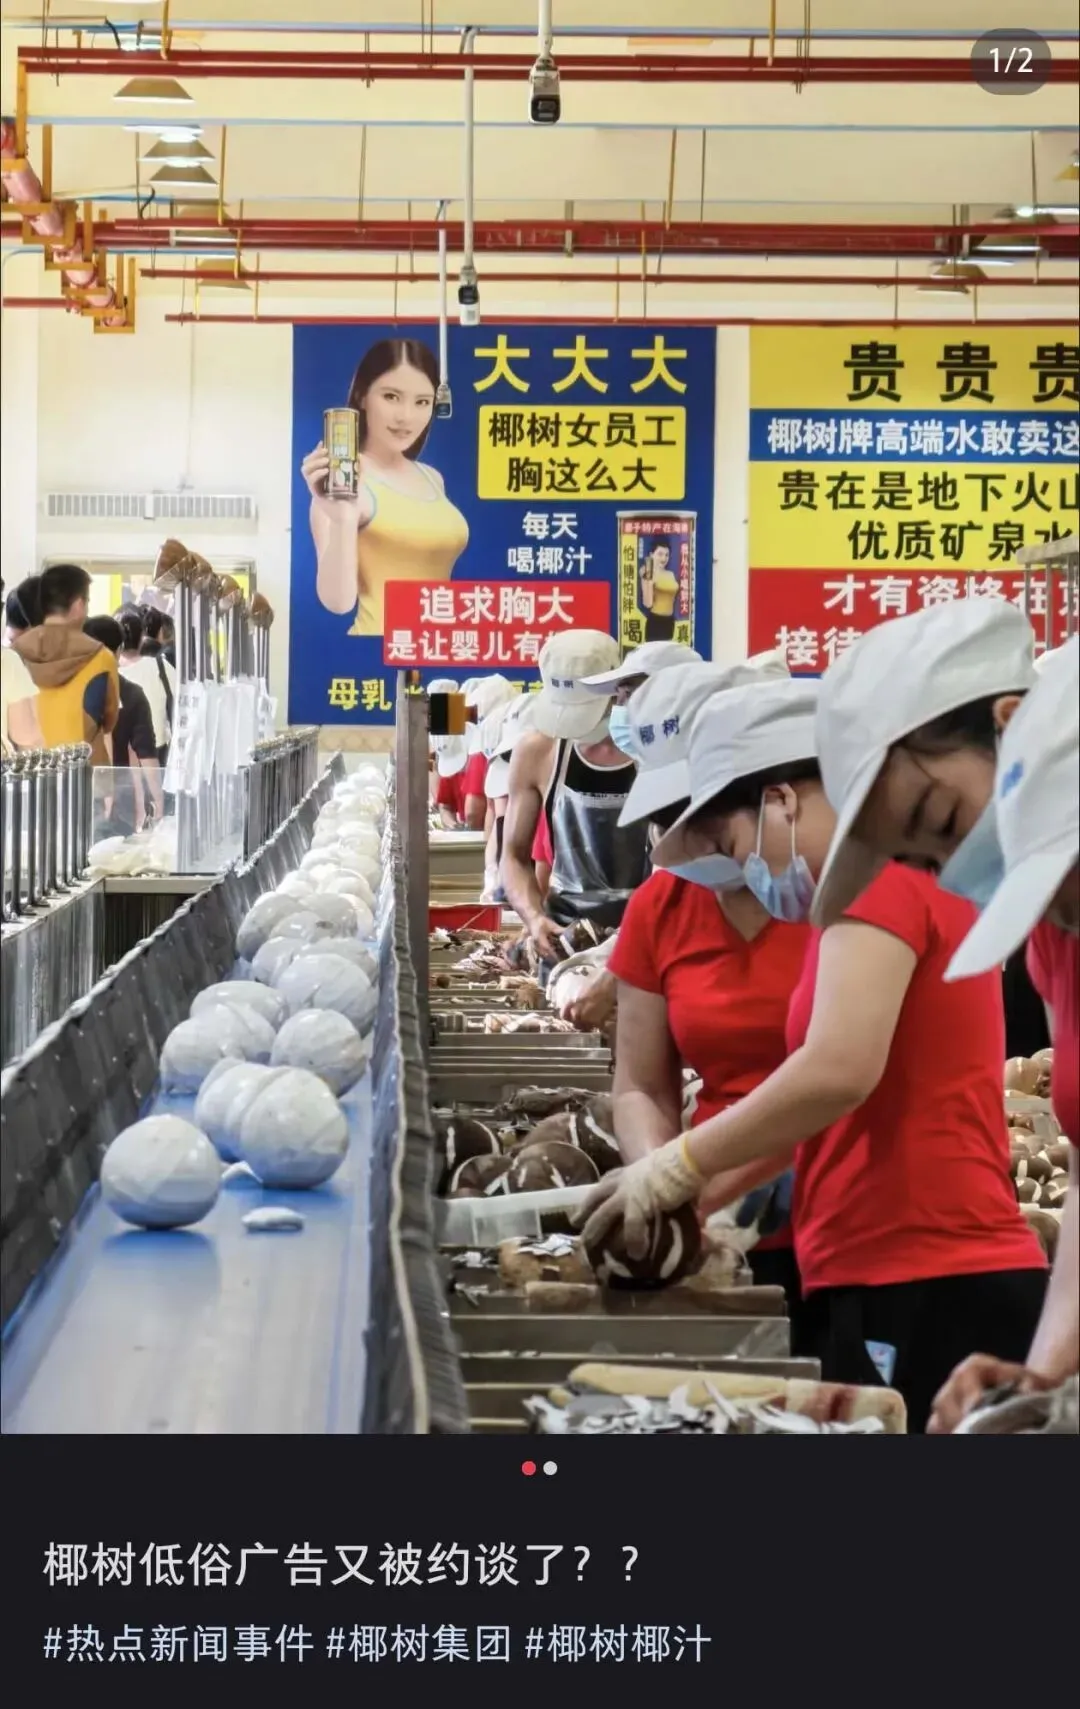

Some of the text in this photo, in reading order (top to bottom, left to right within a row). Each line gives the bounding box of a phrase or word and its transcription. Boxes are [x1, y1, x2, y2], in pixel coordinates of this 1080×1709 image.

[488, 411, 677, 448] 椰树女员工
[767, 417, 1078, 456] 椰树牌高端水敢卖这
[506, 456, 657, 493] 胸这么大
[522, 511, 578, 540] 每天
[506, 546, 592, 574] 喝椰汁
[419, 585, 575, 625] 追求胸大
[387, 629, 554, 662] 是让婴儿有
